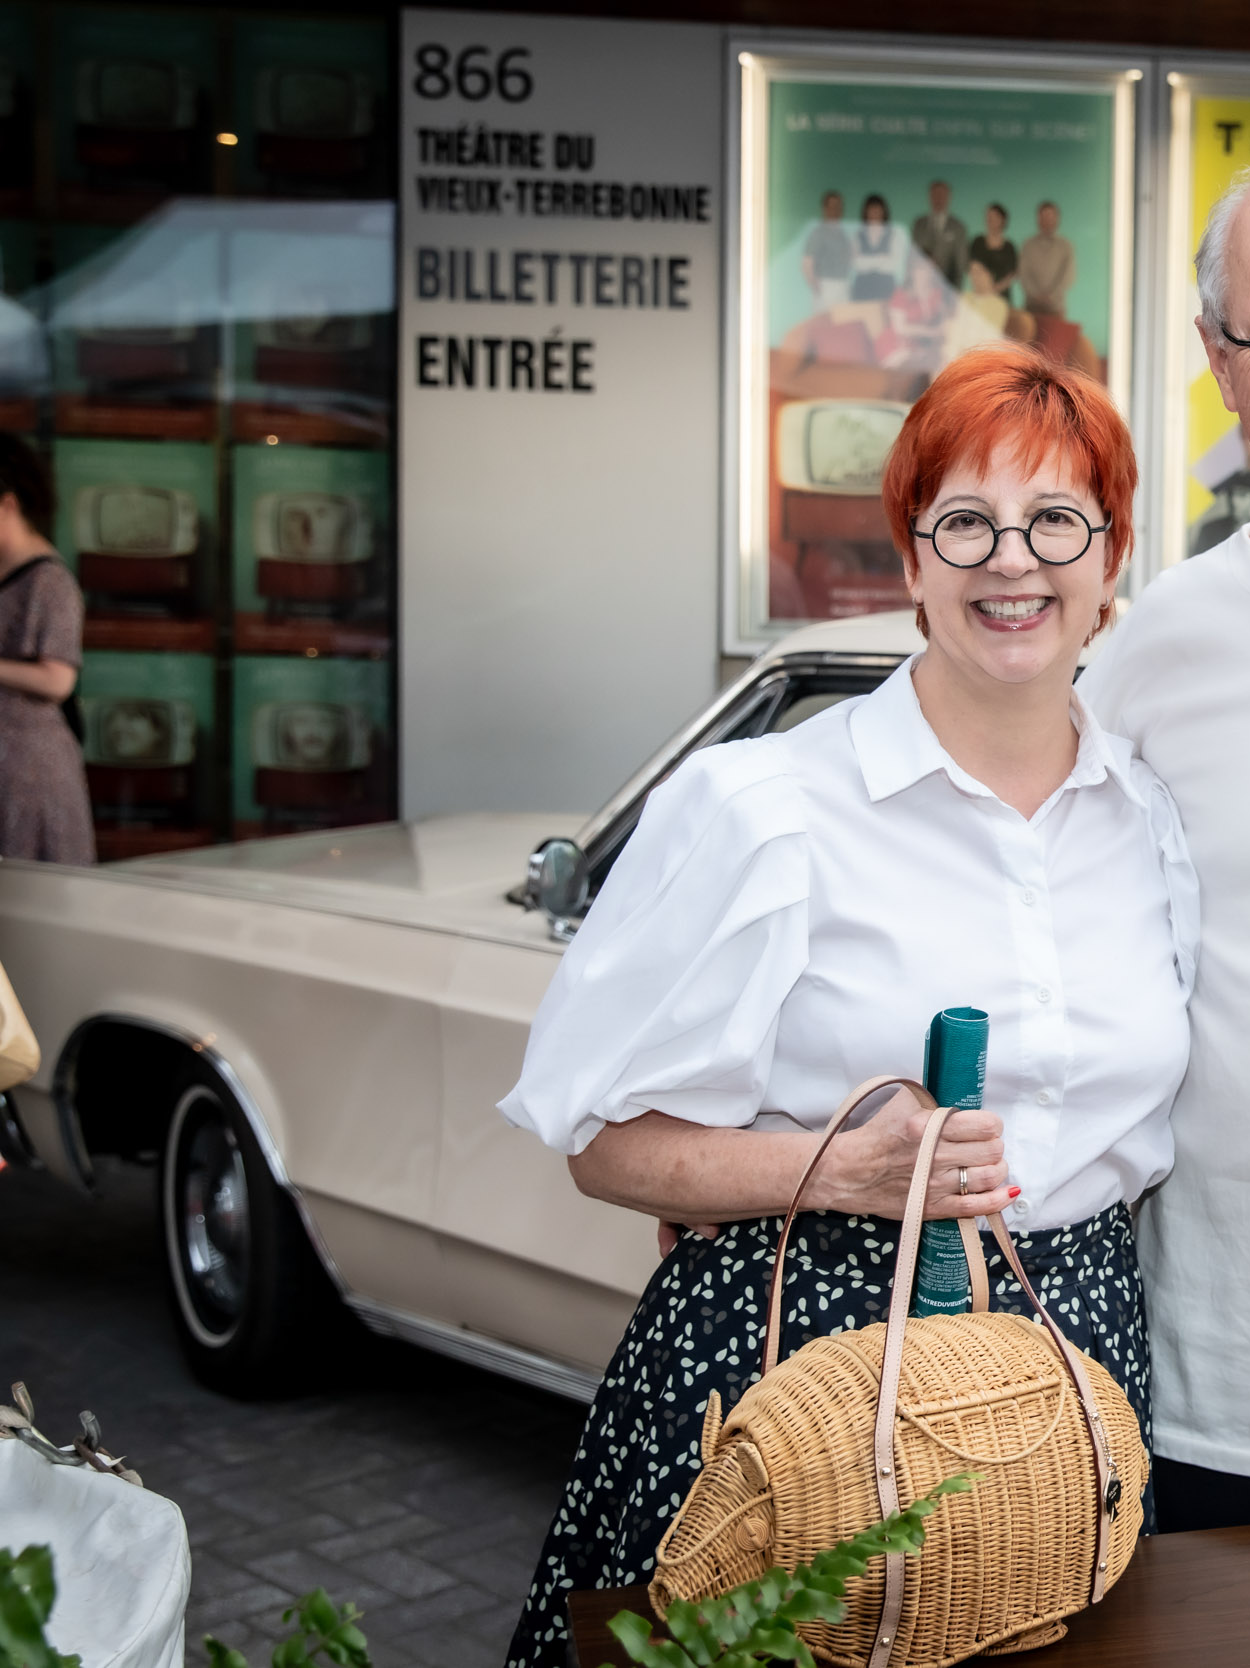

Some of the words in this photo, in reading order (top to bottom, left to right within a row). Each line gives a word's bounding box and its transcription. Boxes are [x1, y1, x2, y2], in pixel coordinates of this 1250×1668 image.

[413, 43, 534, 103] 866
[416, 122, 544, 170] THÉÂTRE
[553, 132, 595, 172] DU
[1214, 119, 1245, 155] T
[415, 175, 710, 222] VIEUX-TERREBONNE
[415, 248, 691, 309] BILLETTERIE
[416, 325, 594, 392] ENTRÉE
